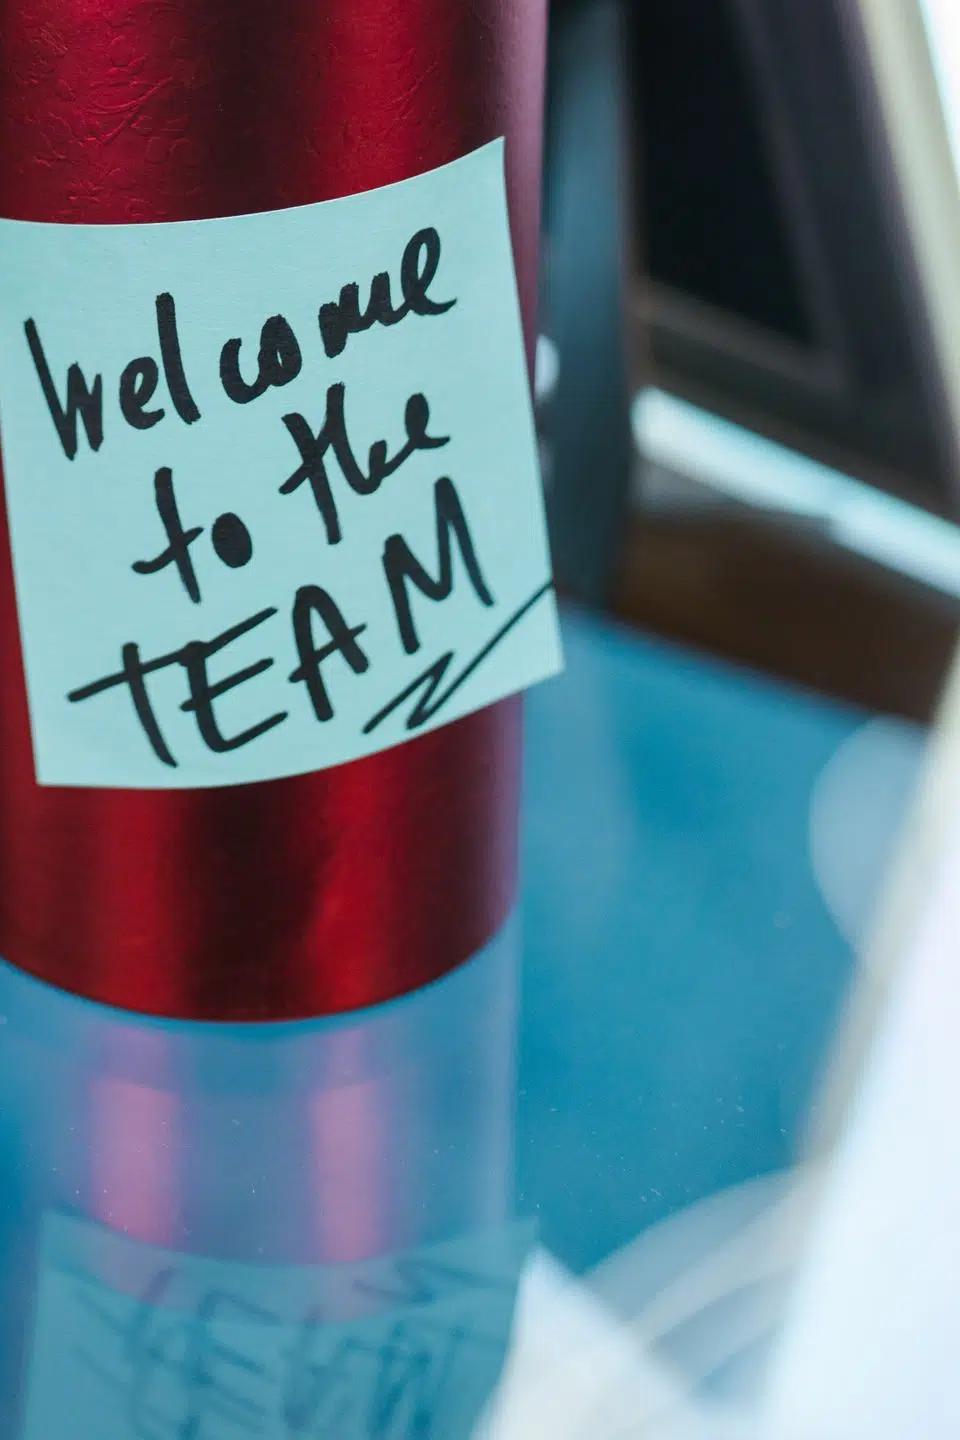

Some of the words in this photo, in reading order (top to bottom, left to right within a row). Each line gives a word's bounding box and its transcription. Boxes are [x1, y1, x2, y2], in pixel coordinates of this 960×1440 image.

[66, 476, 495, 768] TEAM
[131, 466, 253, 605] to
[278, 381, 451, 546] the
